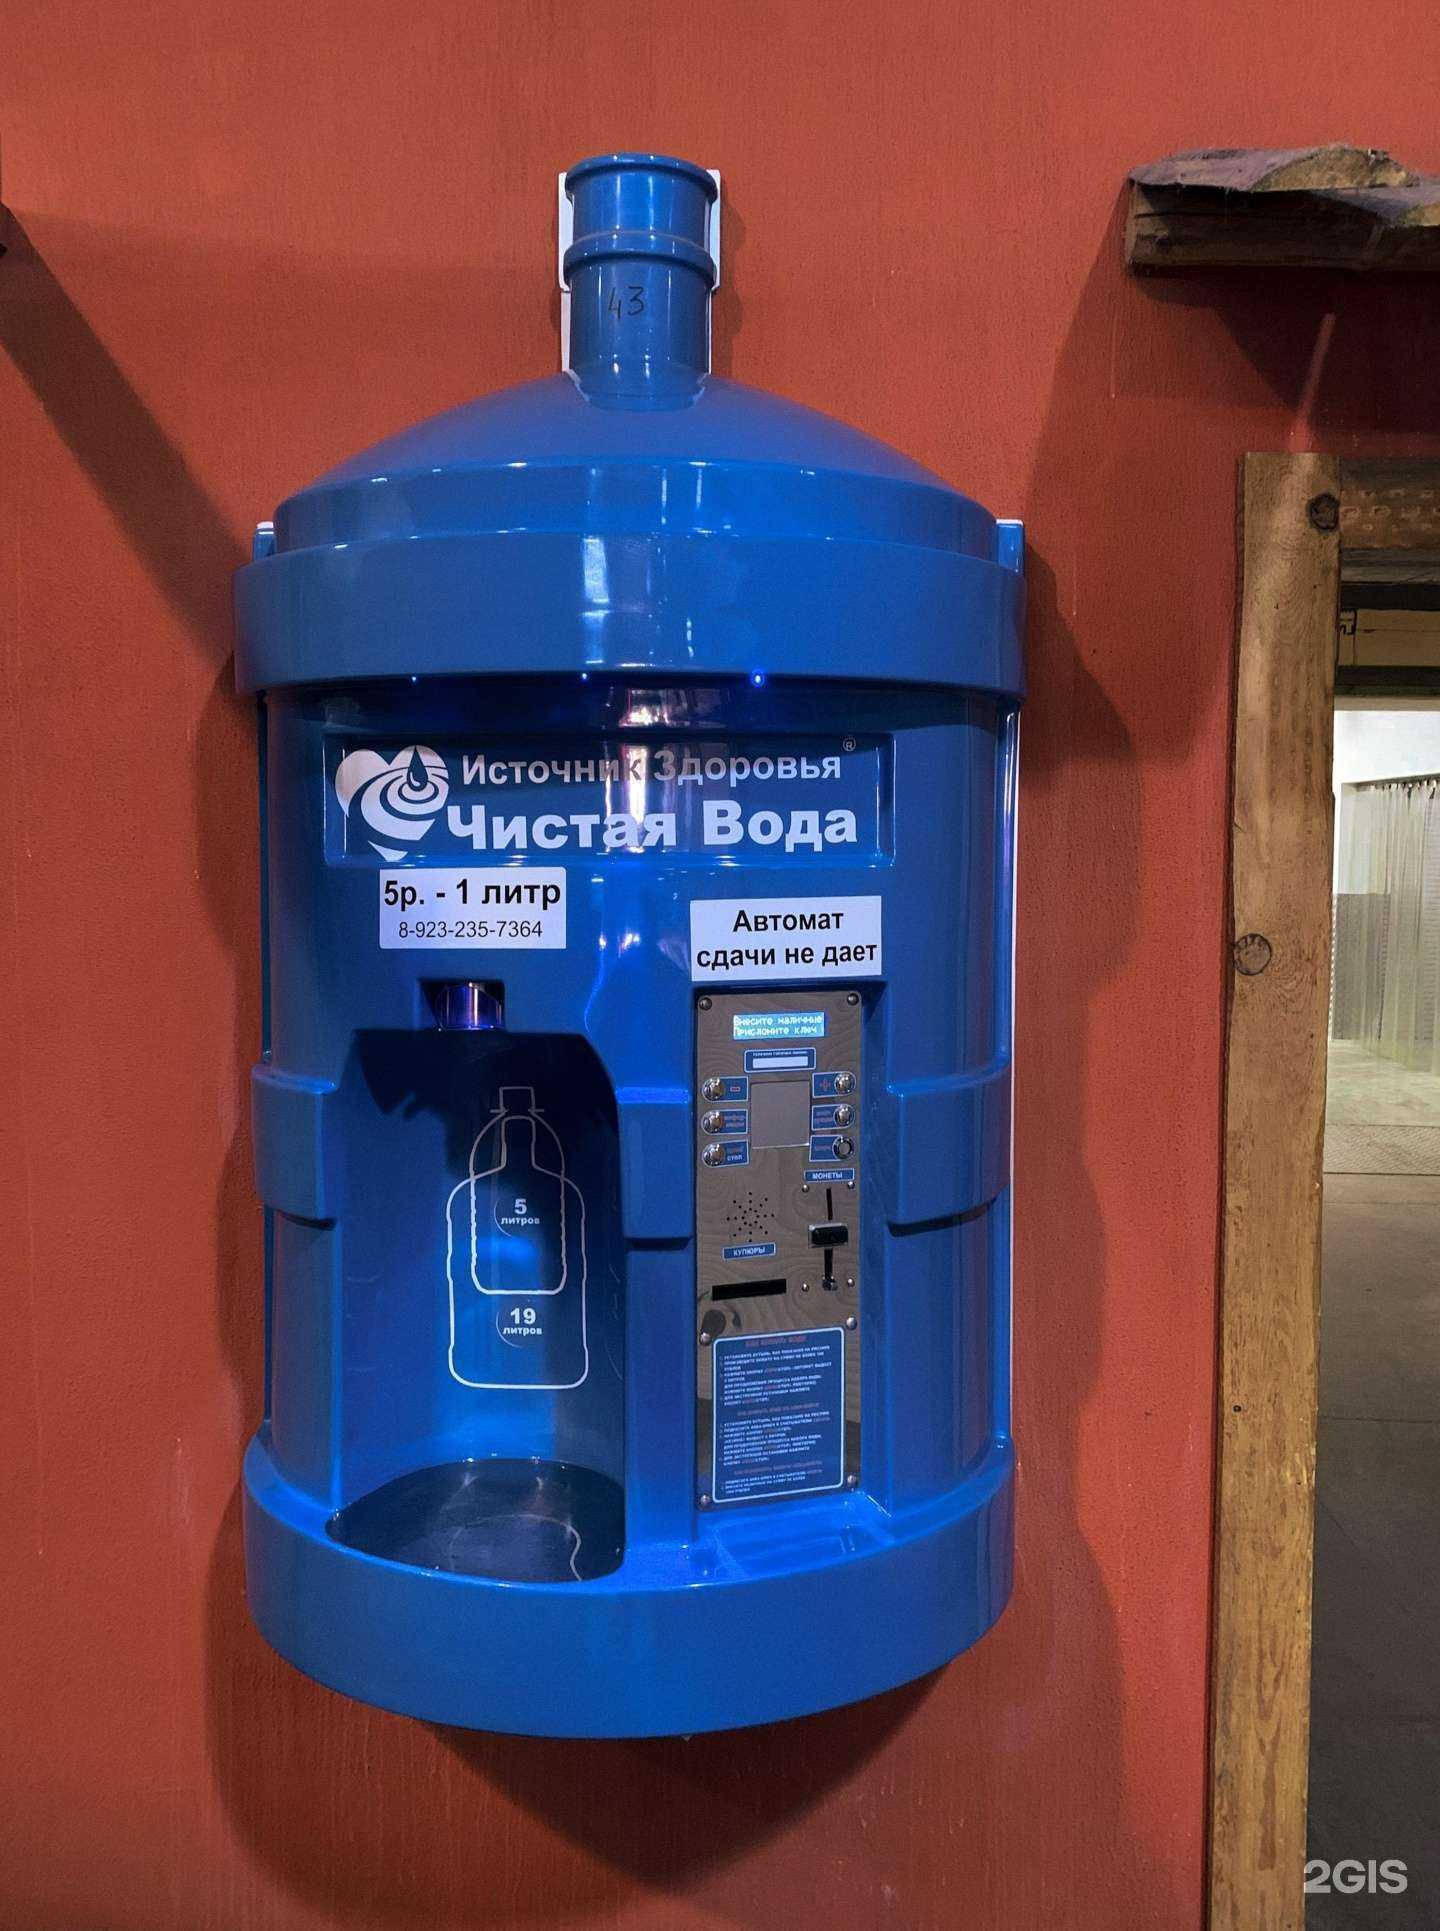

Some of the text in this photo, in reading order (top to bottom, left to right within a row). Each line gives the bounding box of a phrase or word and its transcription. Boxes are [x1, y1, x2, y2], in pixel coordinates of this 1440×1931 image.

[607, 286, 645, 320] 43
[462, 755, 642, 785] Источник
[653, 750, 841, 787] Здоровья
[447, 799, 858, 853] Чистая Вода
[384, 880, 425, 912] 5р.
[456, 878, 468, 904] 1
[481, 884, 561, 911] литр
[398, 920, 543, 938] 8-923-235-7364
[732, 909, 844, 933] Автомат
[696, 944, 877, 971] сдачи не дает
[812, 1172, 843, 1180] МОНЕТЫ
[514, 1198, 527, 1215] 5
[501, 1217, 540, 1226] литров
[733, 1246, 766, 1256] КУПЮРЫ
[510, 1307, 536, 1325] 19
[503, 1327, 543, 1337] литров
